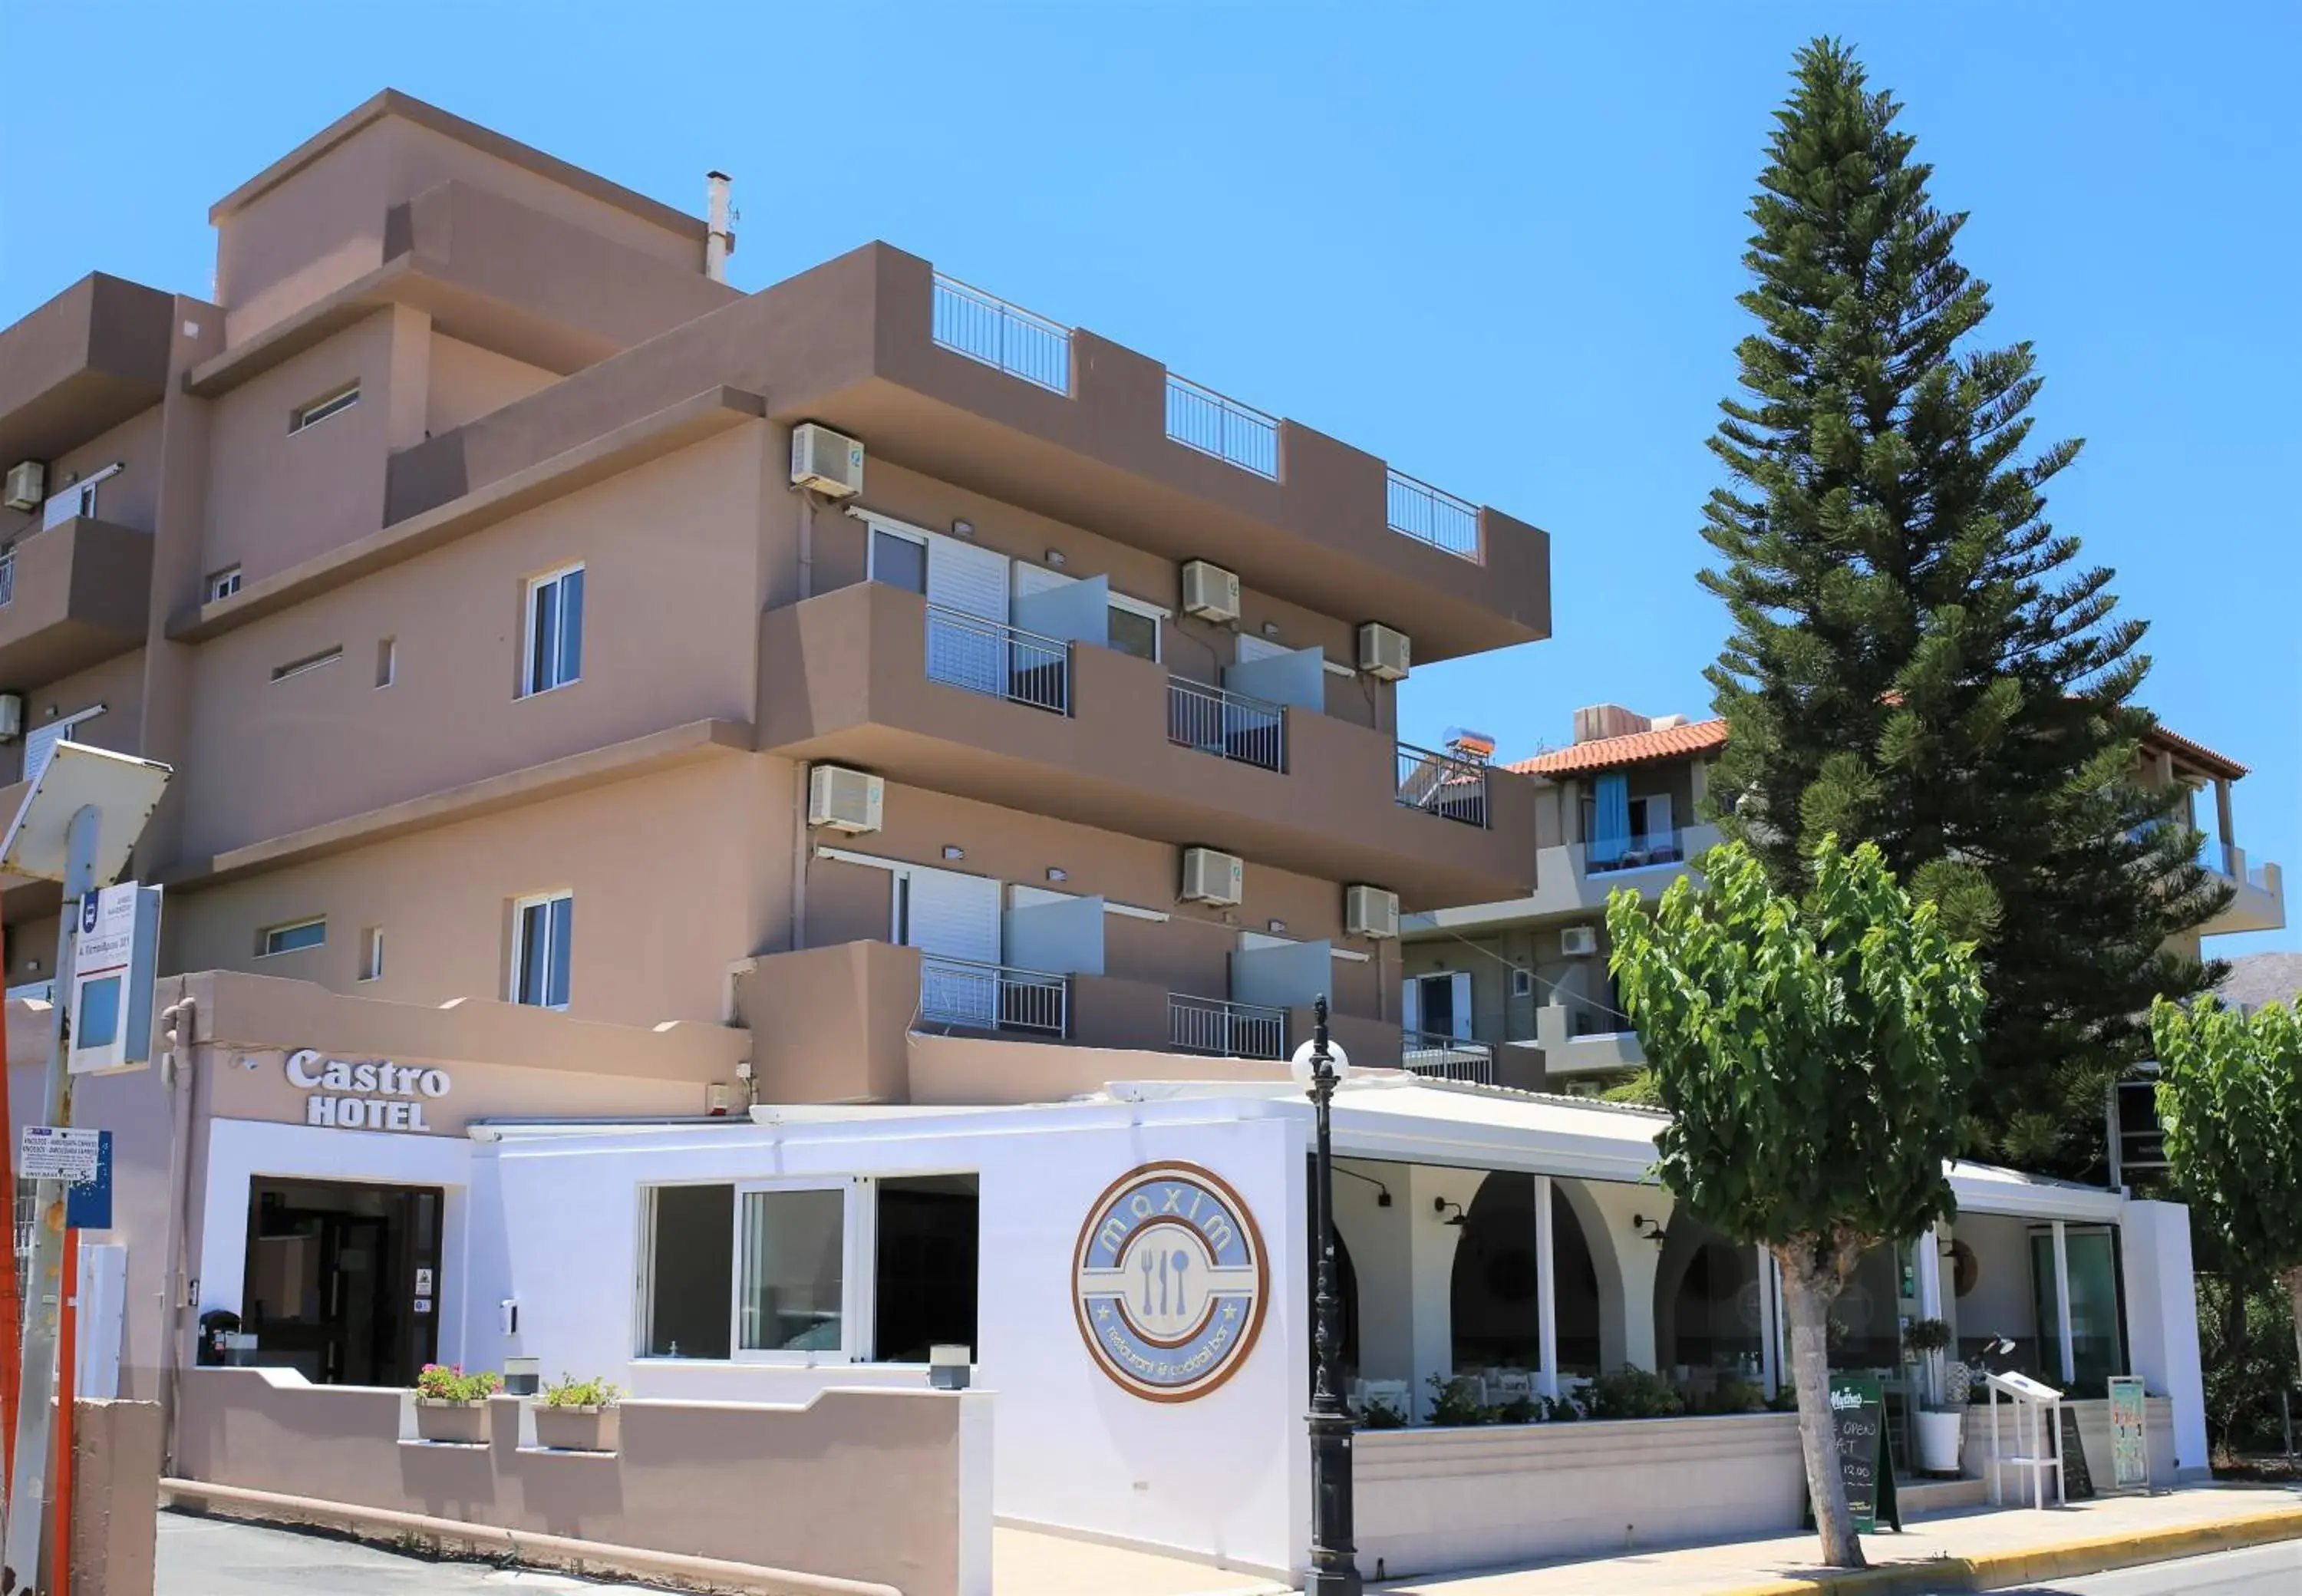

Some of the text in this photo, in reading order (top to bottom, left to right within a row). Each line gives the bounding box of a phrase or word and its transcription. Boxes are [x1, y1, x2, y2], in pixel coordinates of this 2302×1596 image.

[285, 1049, 451, 1098] Castro
[308, 1095, 430, 1132] HOTEL
[1107, 1325, 1154, 1373] restaurant
[1170, 1346, 1213, 1376] cocktail
[1208, 1324, 1228, 1351] bar
